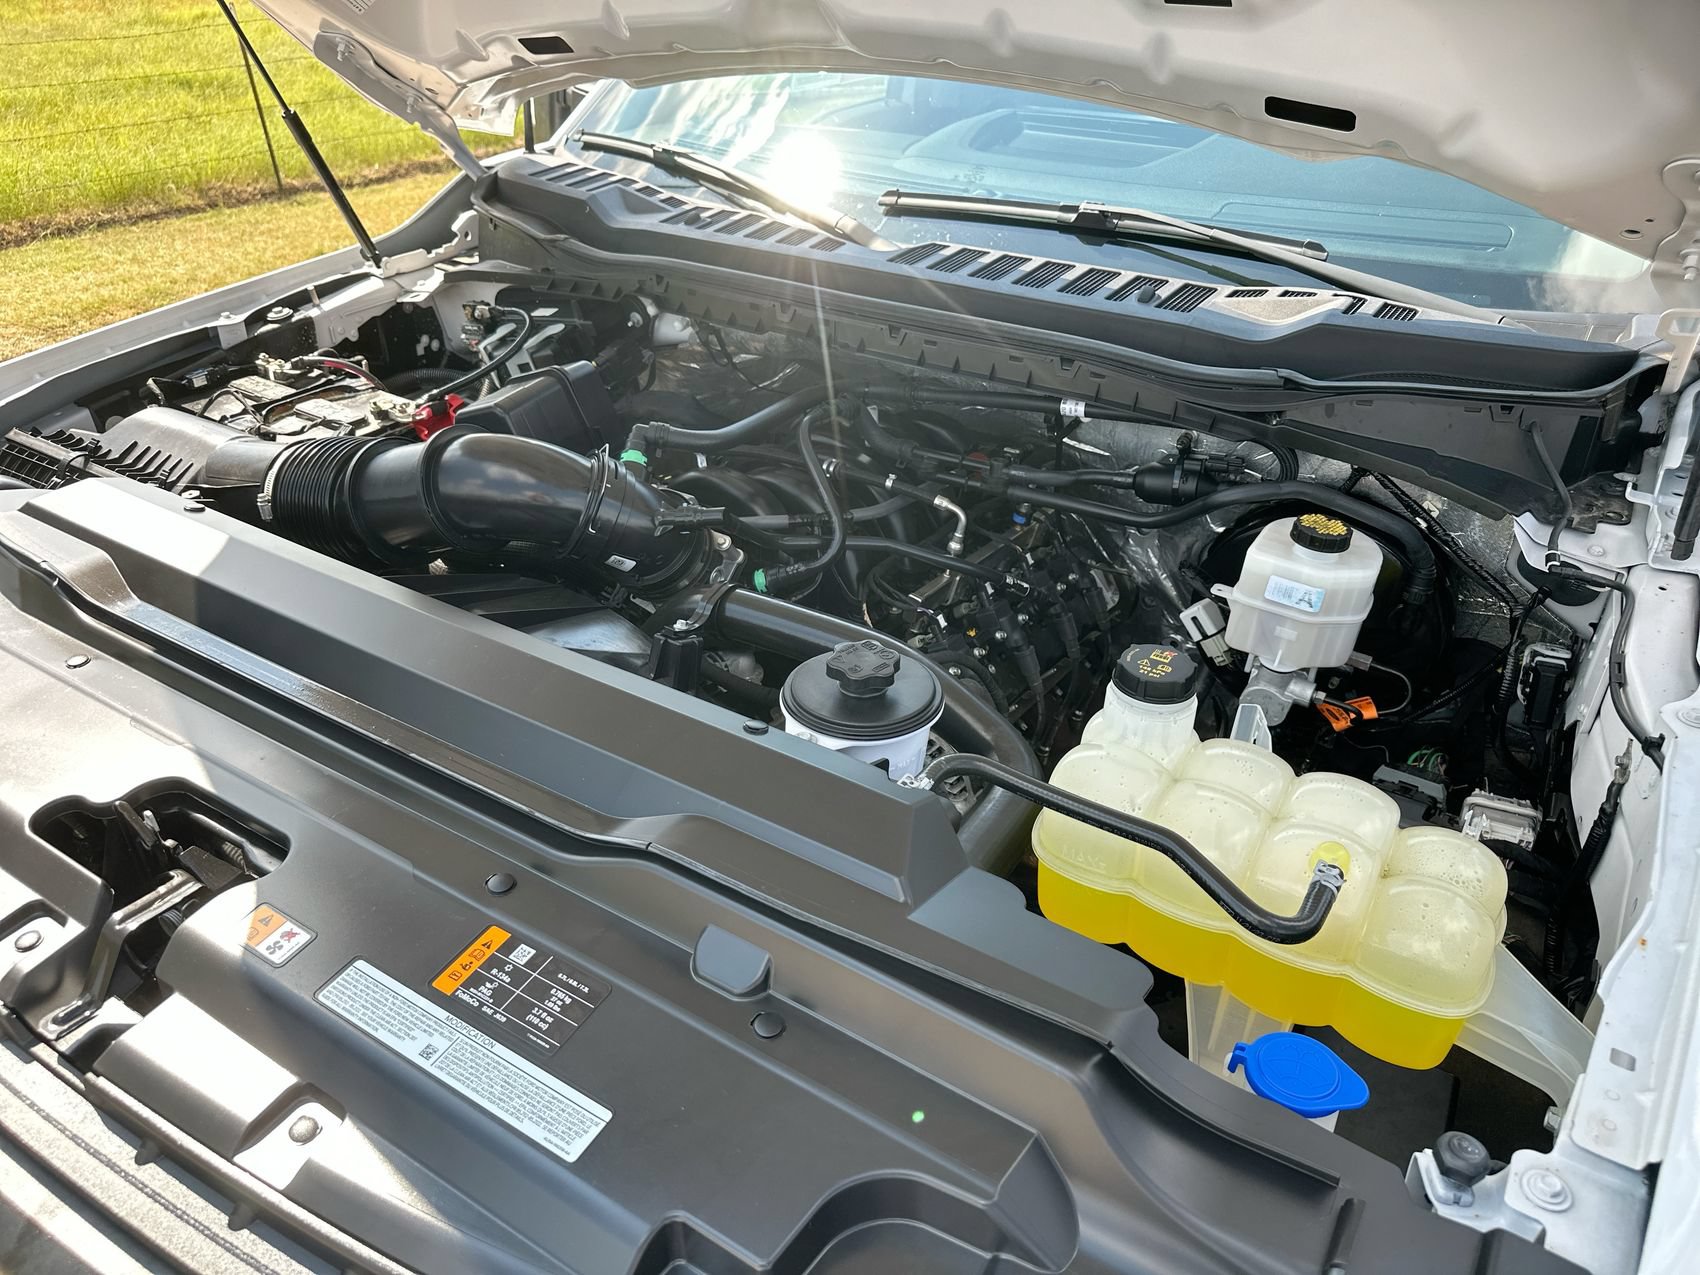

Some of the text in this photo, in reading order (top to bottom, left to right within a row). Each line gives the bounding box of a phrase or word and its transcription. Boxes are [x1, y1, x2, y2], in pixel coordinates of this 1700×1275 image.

[490, 968, 511, 982] R-134a
[478, 986, 493, 996] PAG
[455, 990, 480, 1006] FoMoCo
[482, 1006, 494, 1016] SAE
[445, 1014, 496, 1050] MODIFICATION
